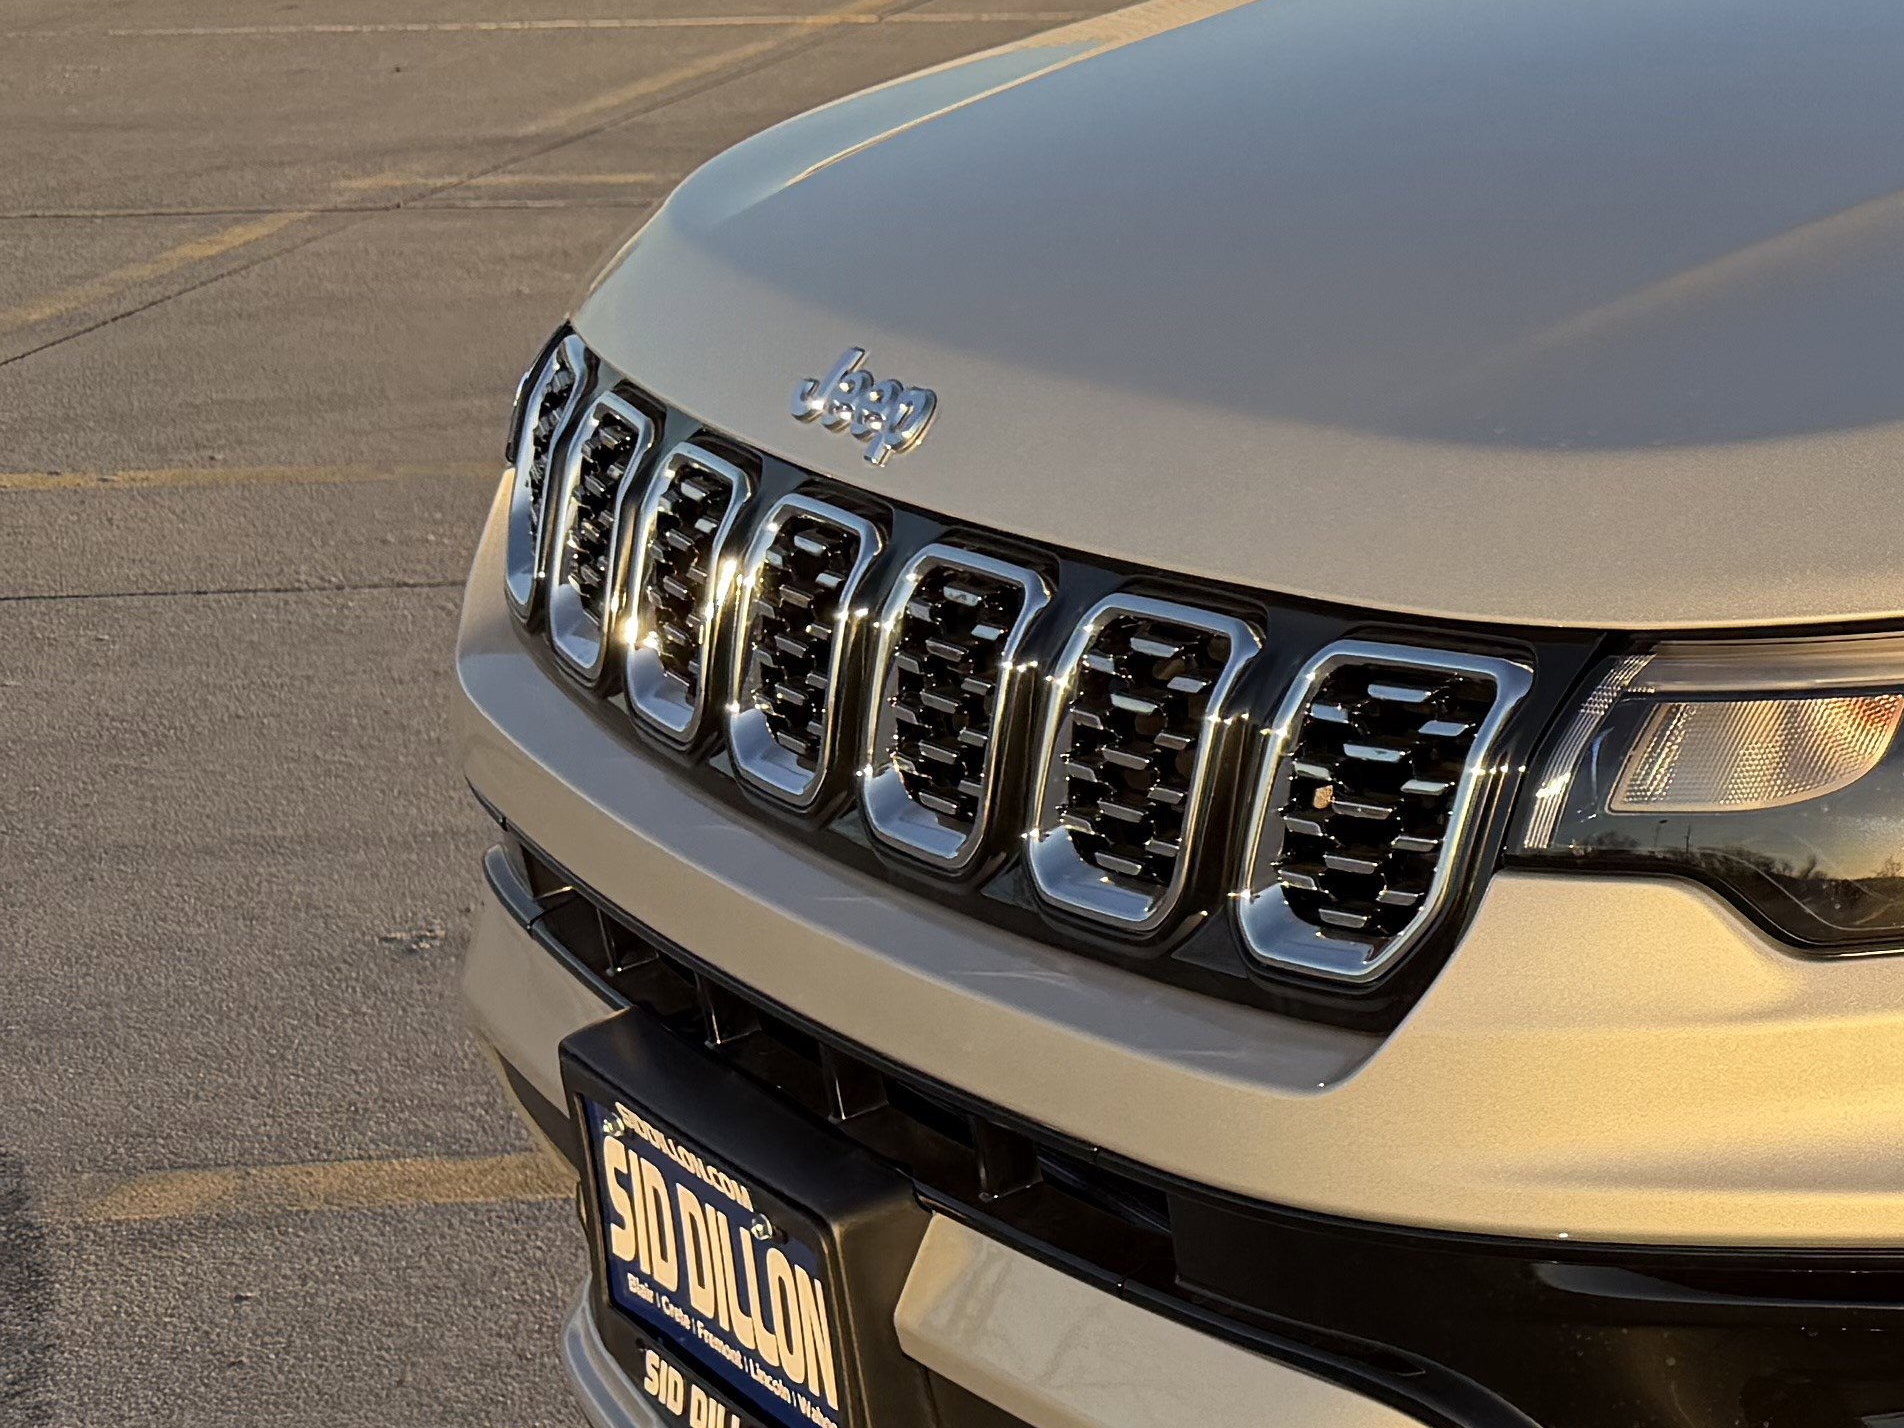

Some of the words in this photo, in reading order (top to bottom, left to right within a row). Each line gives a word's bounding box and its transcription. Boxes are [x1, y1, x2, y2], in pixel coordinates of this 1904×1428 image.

[790, 346, 939, 466] Jeep
[603, 1136, 678, 1293] SID
[675, 1182, 840, 1412] DILLON
[644, 1349, 685, 1417] SID
[749, 1358, 793, 1405] Lincoln
